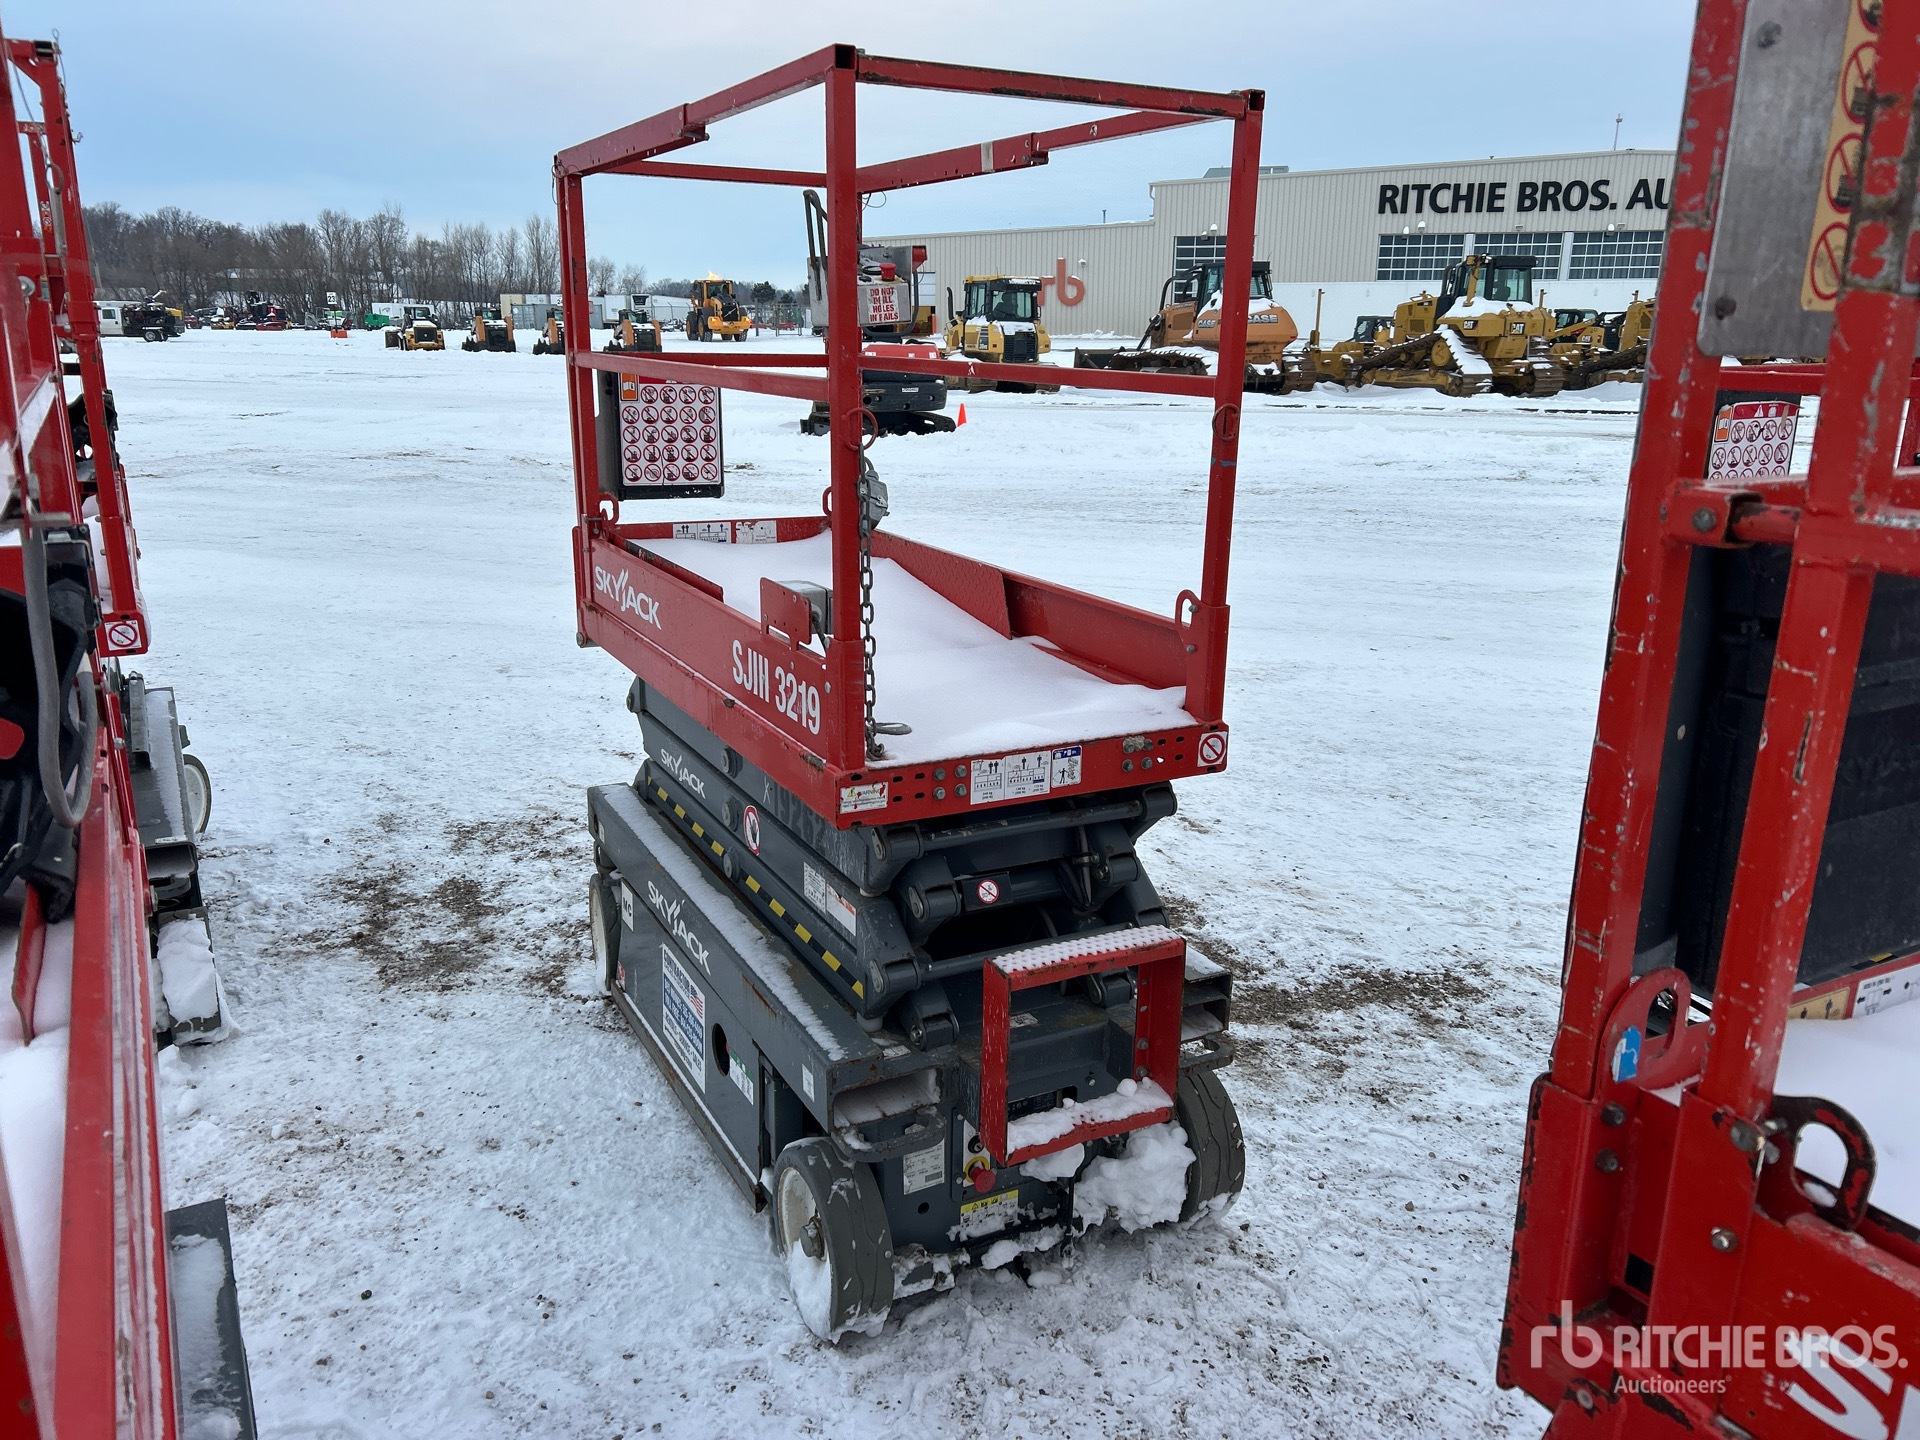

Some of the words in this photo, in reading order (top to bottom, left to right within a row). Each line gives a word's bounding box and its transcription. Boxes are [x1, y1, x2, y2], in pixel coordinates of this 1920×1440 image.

[1378, 182, 1507, 214] RITCHIE
[1517, 179, 1617, 212] BROS.
[881, 287, 894, 296] NOT
[872, 304, 894, 312] HOLES
[1198, 320, 1216, 328] CASE
[1463, 320, 1474, 329] CAT
[1511, 323, 1525, 334] CAT
[594, 565, 662, 630] SKYJACK
[775, 666, 820, 735] 3219
[661, 748, 706, 800] SKYJACK
[648, 880, 712, 976] SKYJACK
